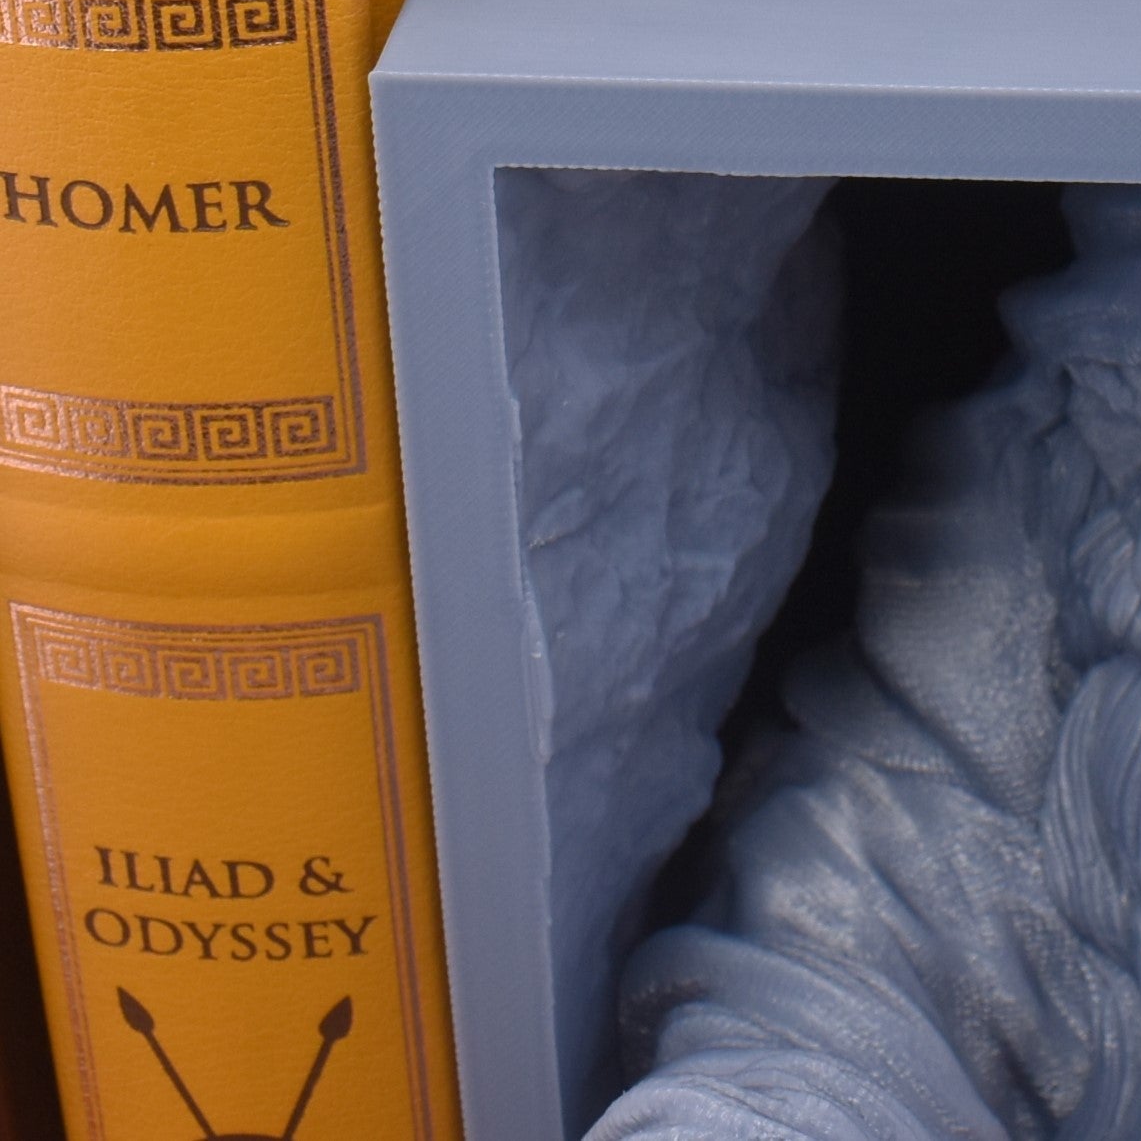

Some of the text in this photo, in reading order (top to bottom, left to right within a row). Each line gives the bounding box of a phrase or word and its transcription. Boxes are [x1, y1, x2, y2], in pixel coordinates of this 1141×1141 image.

[0, 170, 291, 234] HOMER
[94, 845, 354, 900] ILIAD &
[84, 906, 378, 962] ODYSSEY
